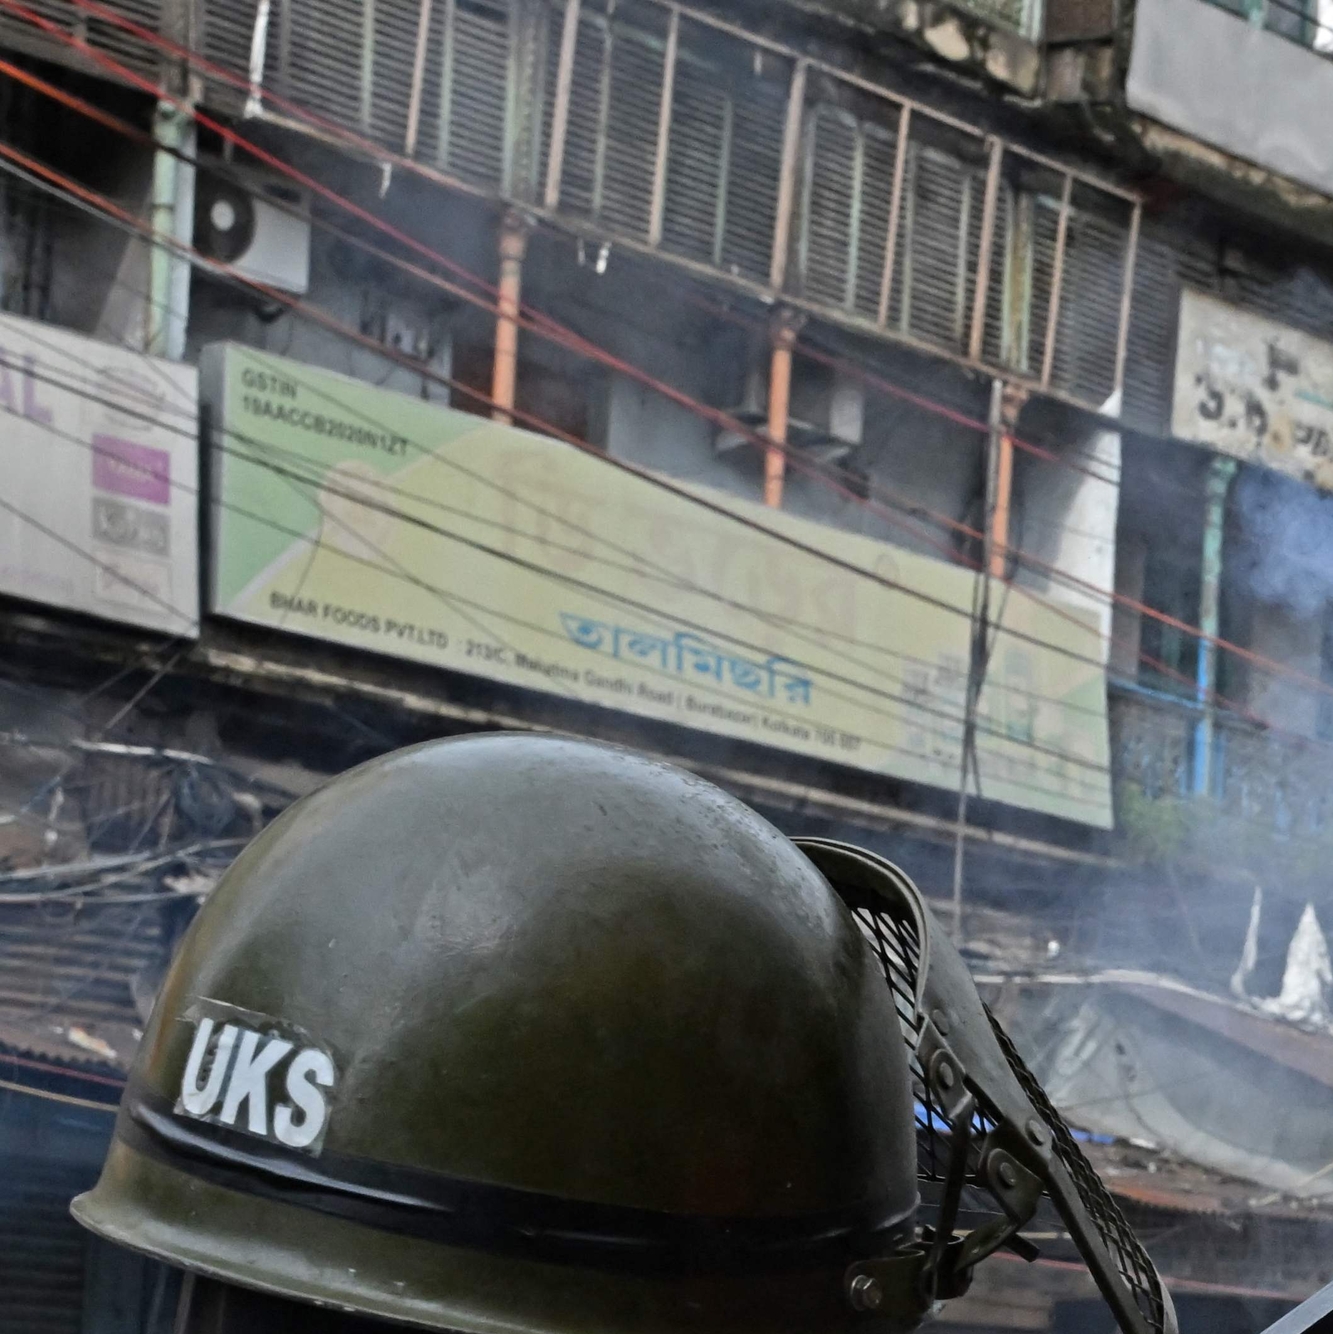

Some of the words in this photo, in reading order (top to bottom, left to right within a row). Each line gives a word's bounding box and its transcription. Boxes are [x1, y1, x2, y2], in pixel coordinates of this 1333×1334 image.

[241, 367, 298, 399] GSTIN
[321, 602, 380, 633] FOODS
[560, 611, 813, 706] তালমিছরি
[183, 1017, 334, 1147] UKS
